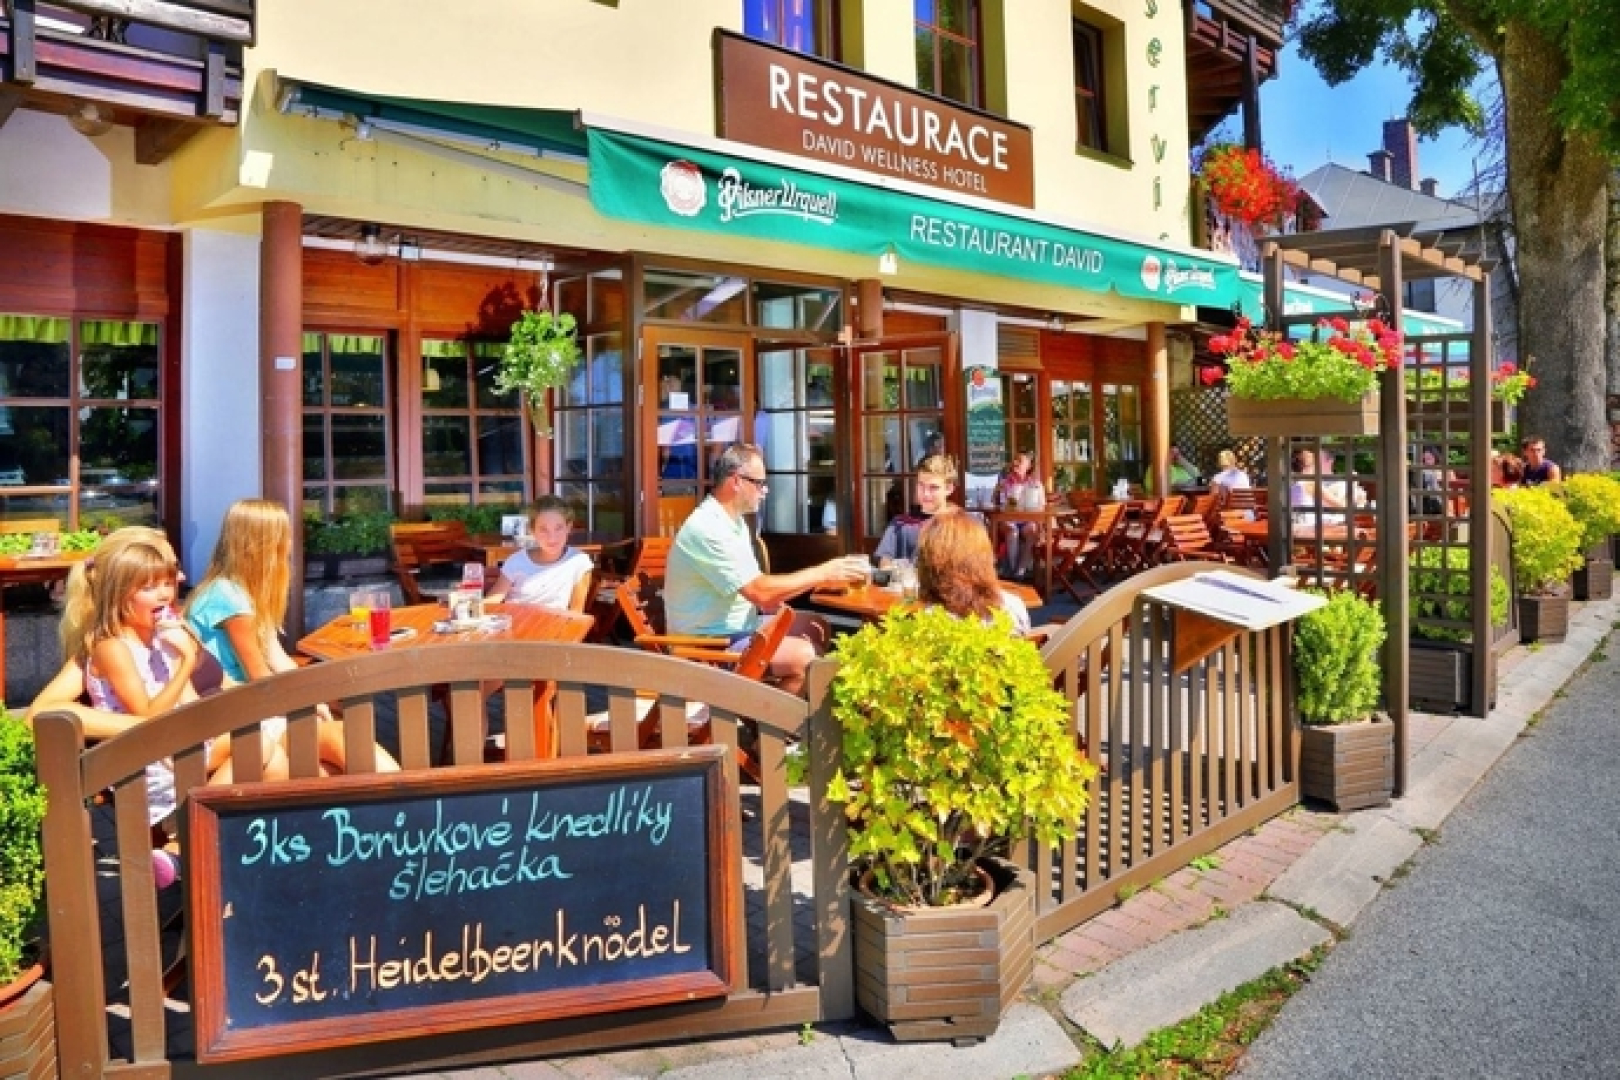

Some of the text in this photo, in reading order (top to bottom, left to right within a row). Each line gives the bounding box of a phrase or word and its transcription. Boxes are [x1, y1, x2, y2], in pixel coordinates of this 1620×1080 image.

[768, 63, 1009, 171] RESTAURACE
[1145, 0, 1169, 241] servi
[802, 128, 988, 194] DAVID WELLNESS HOTEL
[717, 166, 838, 224] Pilsner Urquell
[910, 214, 1104, 274] RESTAURANT DAVID
